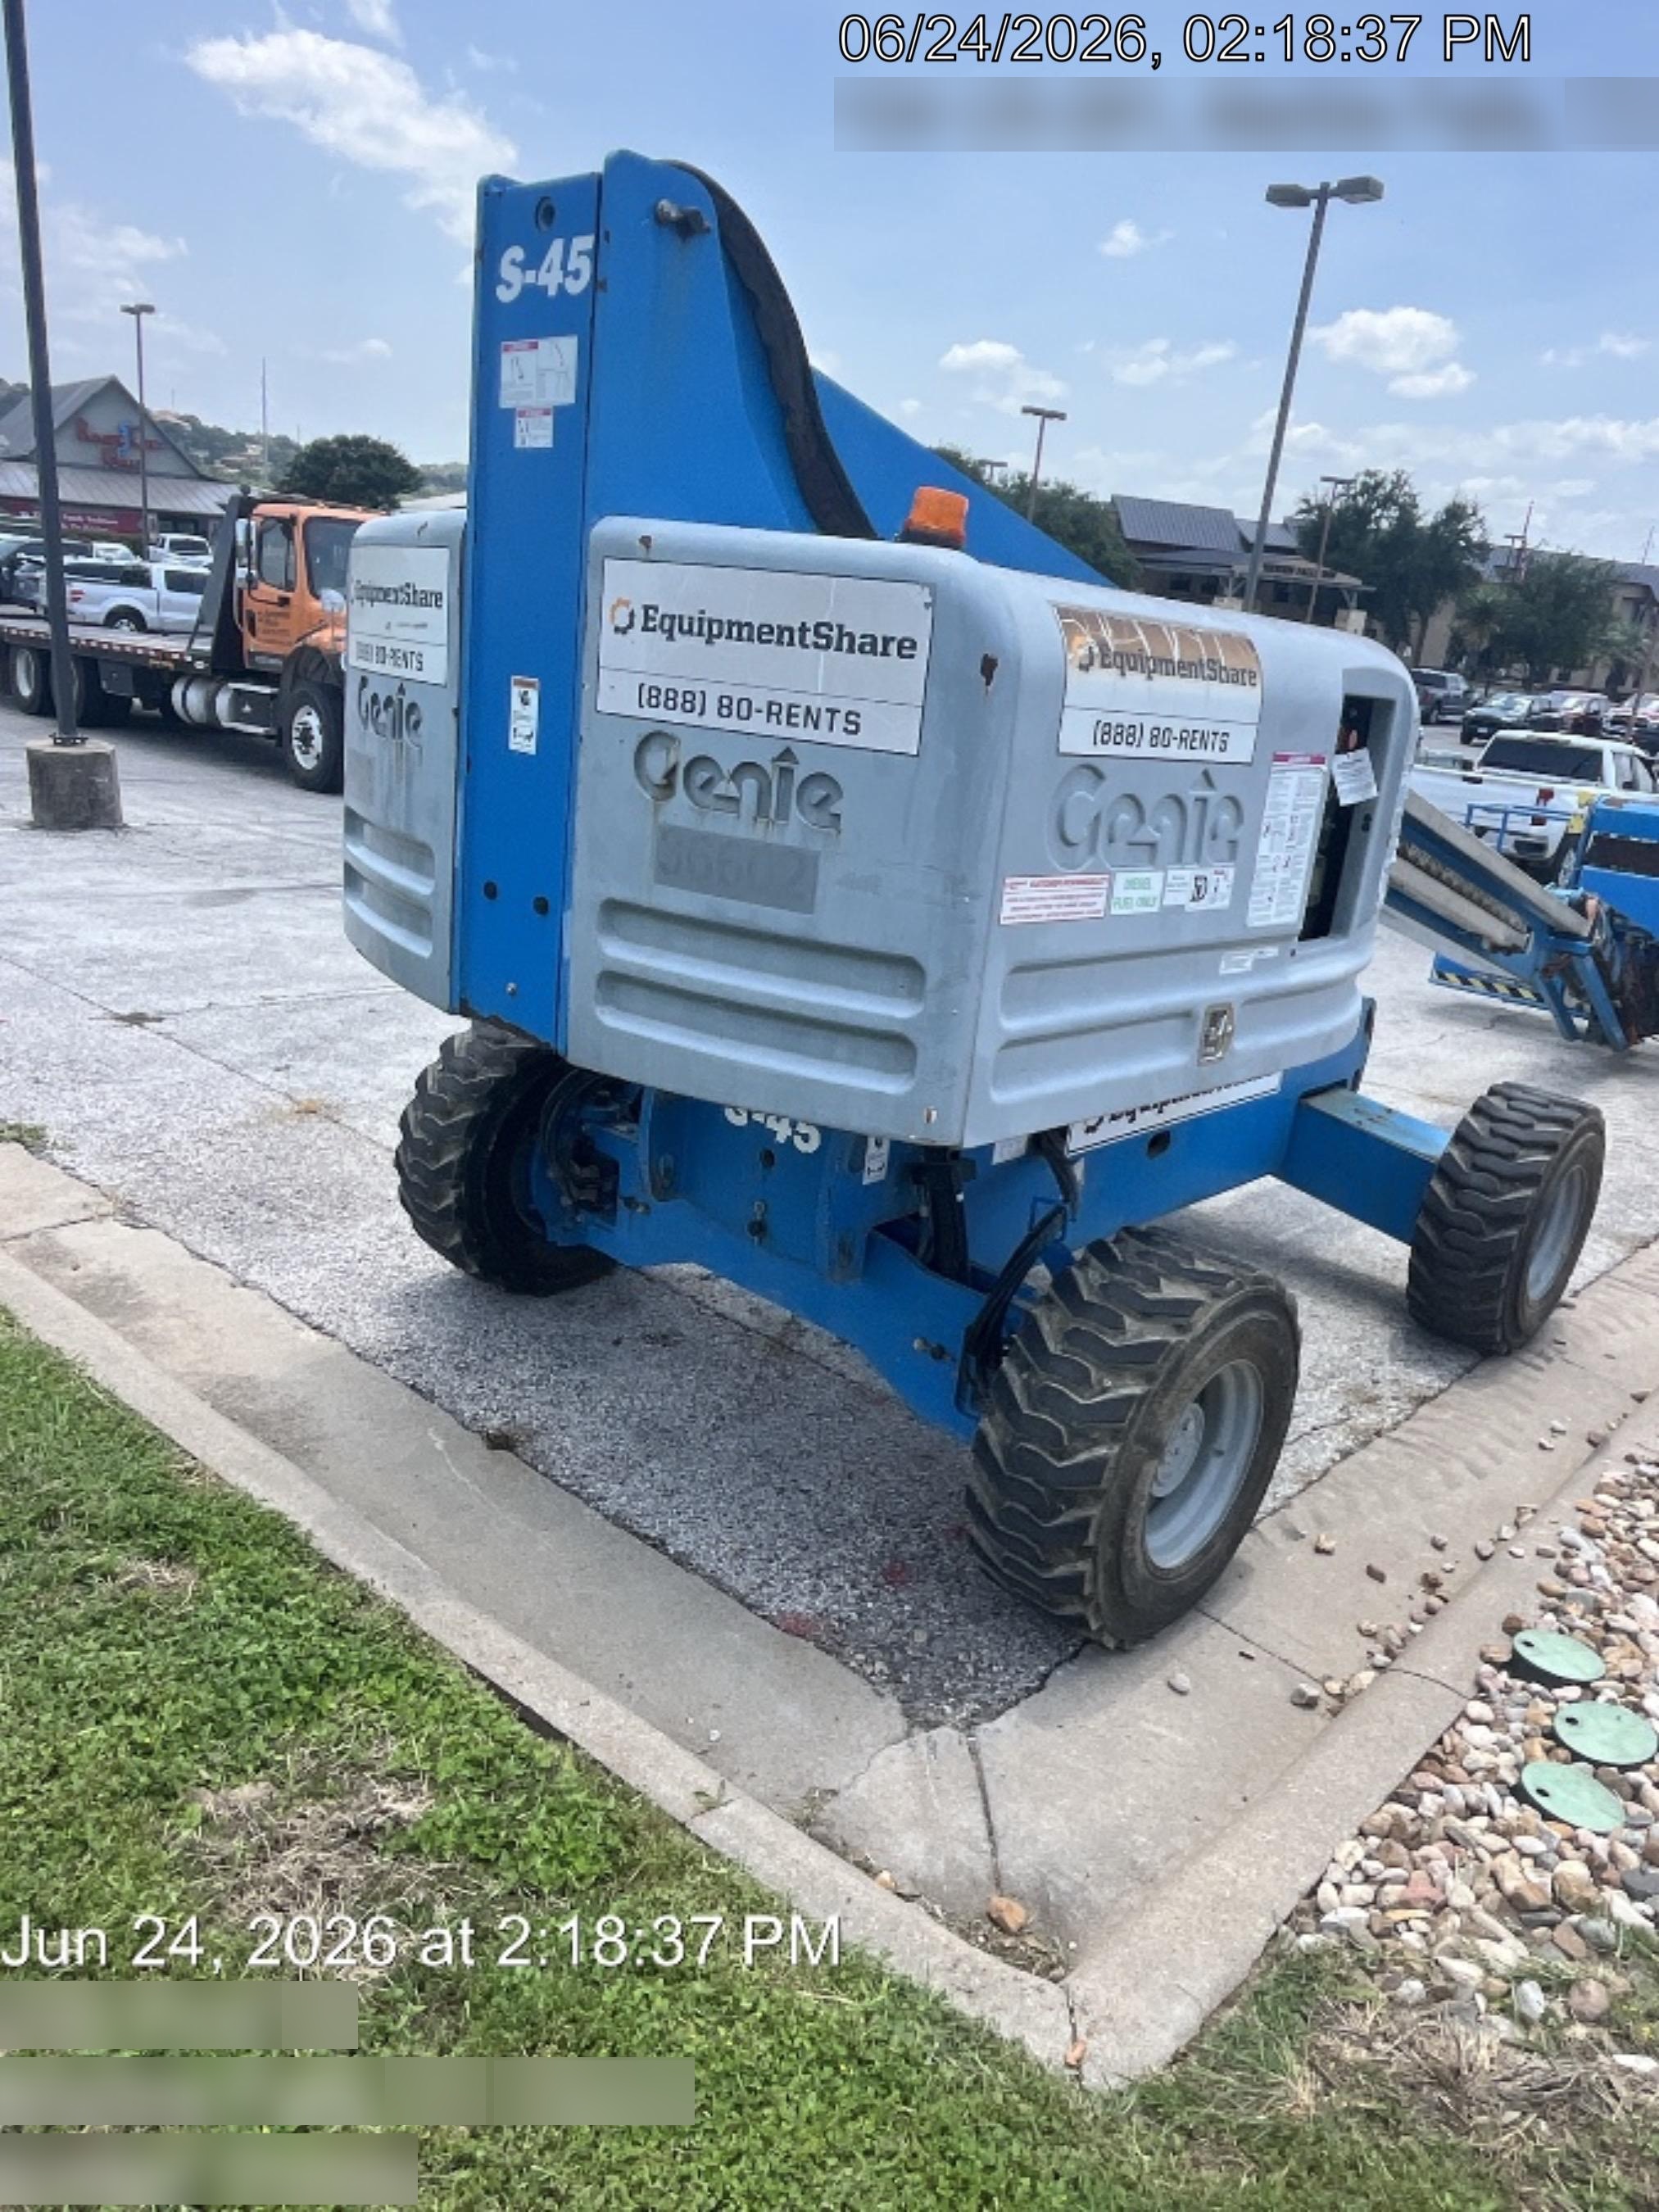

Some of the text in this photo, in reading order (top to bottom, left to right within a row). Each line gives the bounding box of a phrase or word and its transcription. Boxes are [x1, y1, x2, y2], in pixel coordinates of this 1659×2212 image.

[496, 234, 596, 303] S-45
[641, 604, 917, 660] EquipmentShare
[1100, 649, 1257, 687] EquipmentShare
[637, 682, 861, 736] (888) 80-RENTS
[1093, 719, 1230, 753] (888) 80-RENTS
[634, 729, 843, 832] Genie
[1047, 764, 1244, 873] Genie
